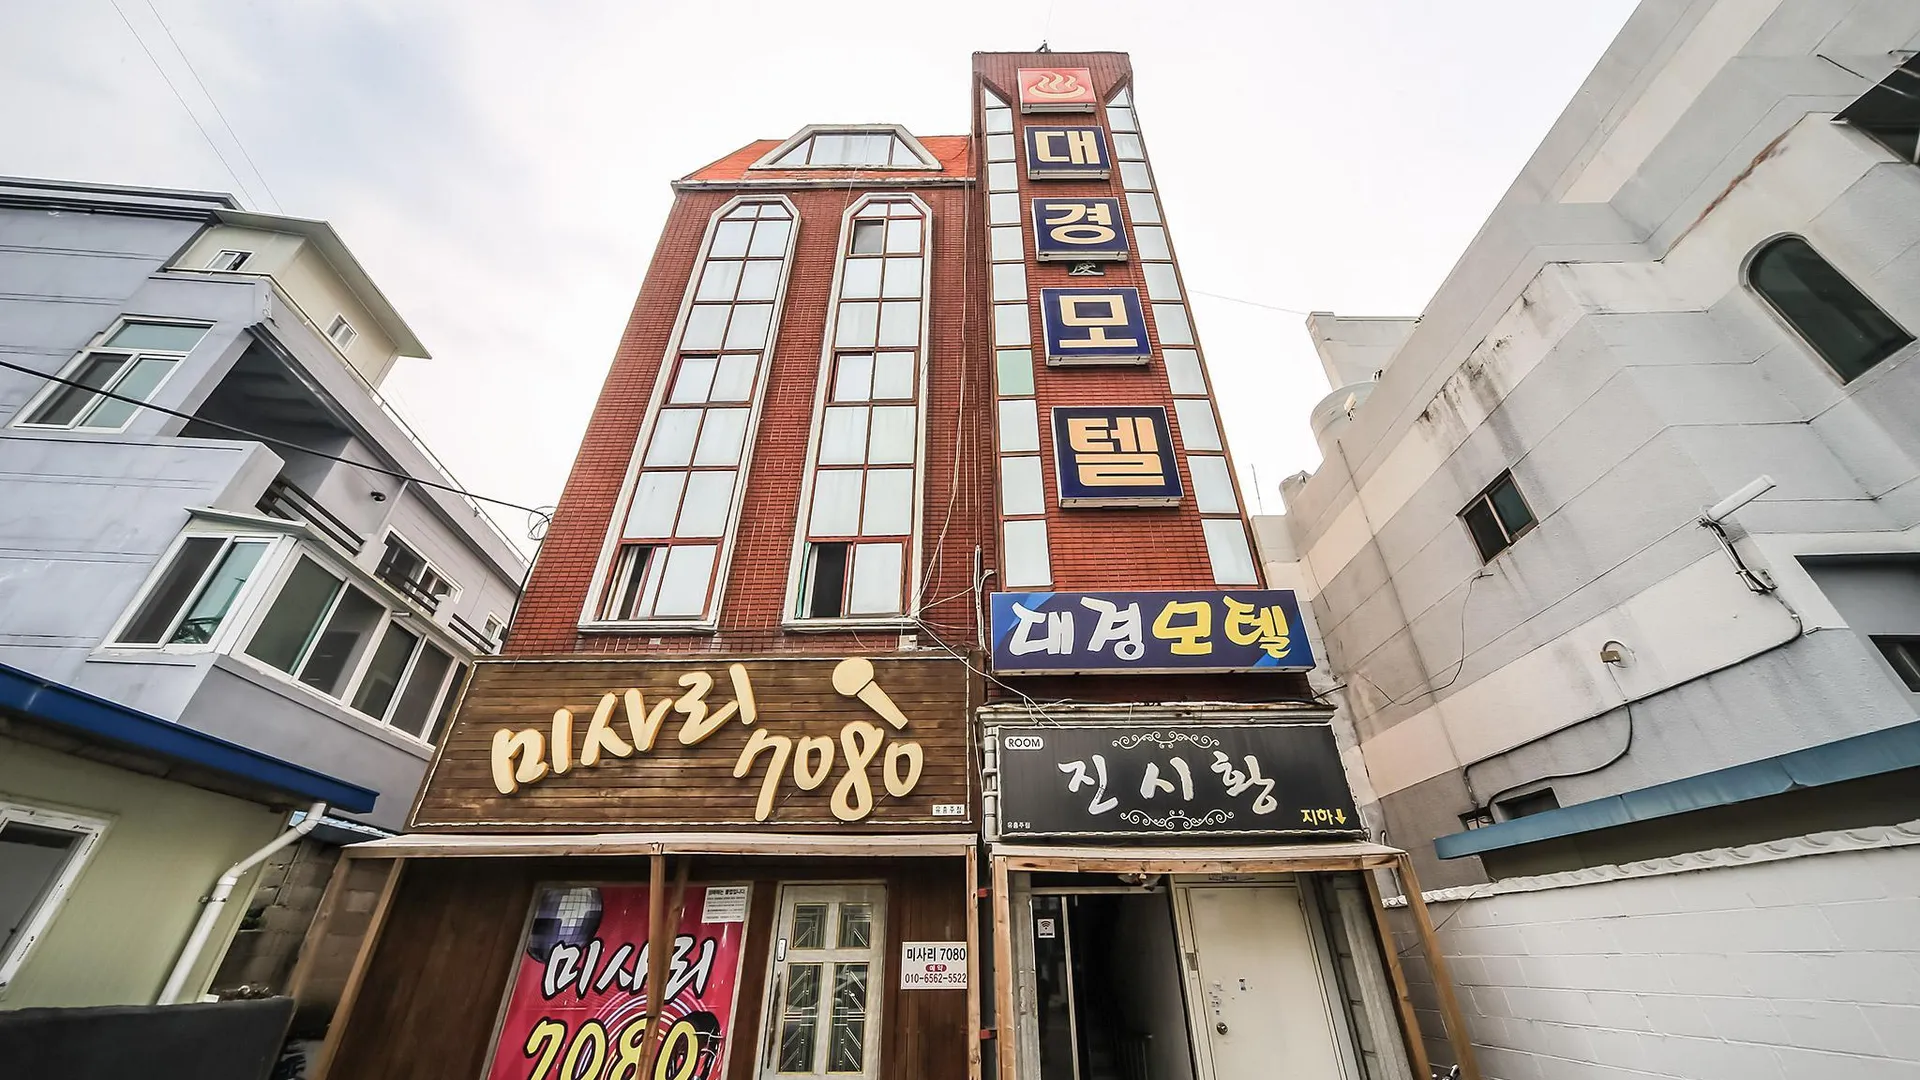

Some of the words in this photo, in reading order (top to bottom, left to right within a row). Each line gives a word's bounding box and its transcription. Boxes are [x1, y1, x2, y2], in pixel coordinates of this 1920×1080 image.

[491, 663, 758, 794] 미사리
[1008, 738, 1041, 748] ROOM
[733, 720, 923, 822] 7080
[1300, 808, 1334, 826] 지하
[906, 947, 937, 962] 미사리
[940, 947, 966, 961] 7080
[904, 973, 967, 983] 010-6562-5522
